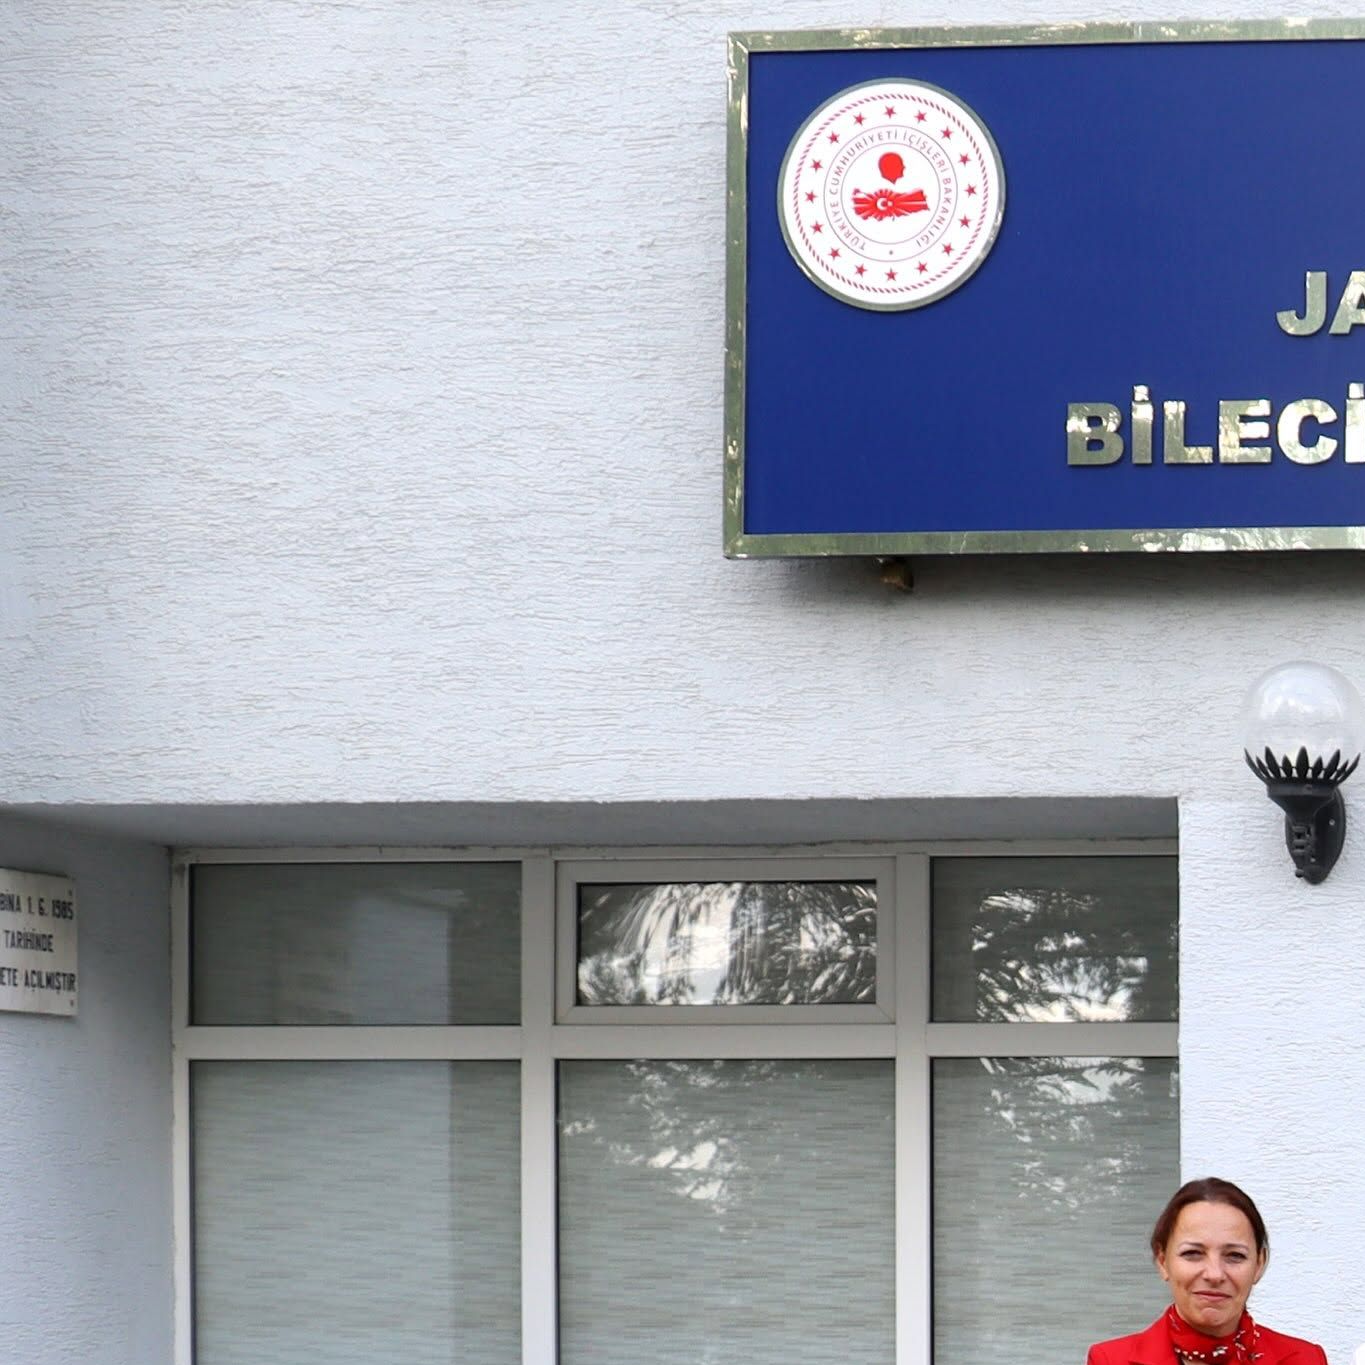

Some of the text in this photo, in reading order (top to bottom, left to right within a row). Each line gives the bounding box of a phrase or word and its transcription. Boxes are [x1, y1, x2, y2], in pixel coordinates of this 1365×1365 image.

[829, 128, 952, 251] TÜRKİYE CUMHURİYETİ İÇİŞLERİ BAKANLIĞI
